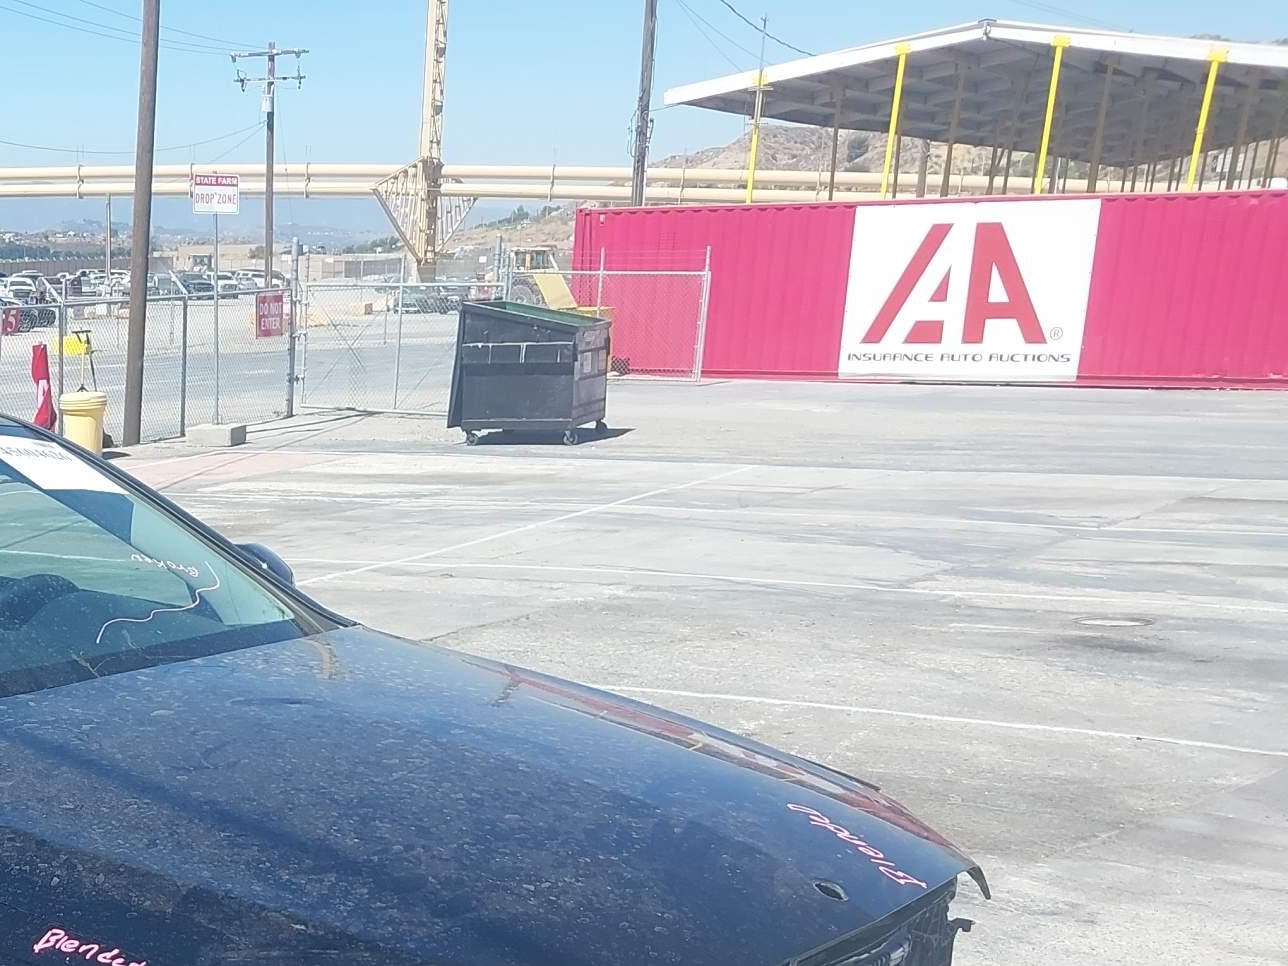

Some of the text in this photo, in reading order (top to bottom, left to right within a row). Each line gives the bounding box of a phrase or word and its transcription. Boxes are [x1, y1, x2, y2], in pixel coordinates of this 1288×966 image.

[196, 176, 237, 184] STATE FARM
[196, 194, 237, 205] DROP ZONE
[6, 311, 17, 332] 5
[262, 319, 280, 329] ENTER
[847, 352, 1071, 363] INSURANCE AUTO AUCTIONS
